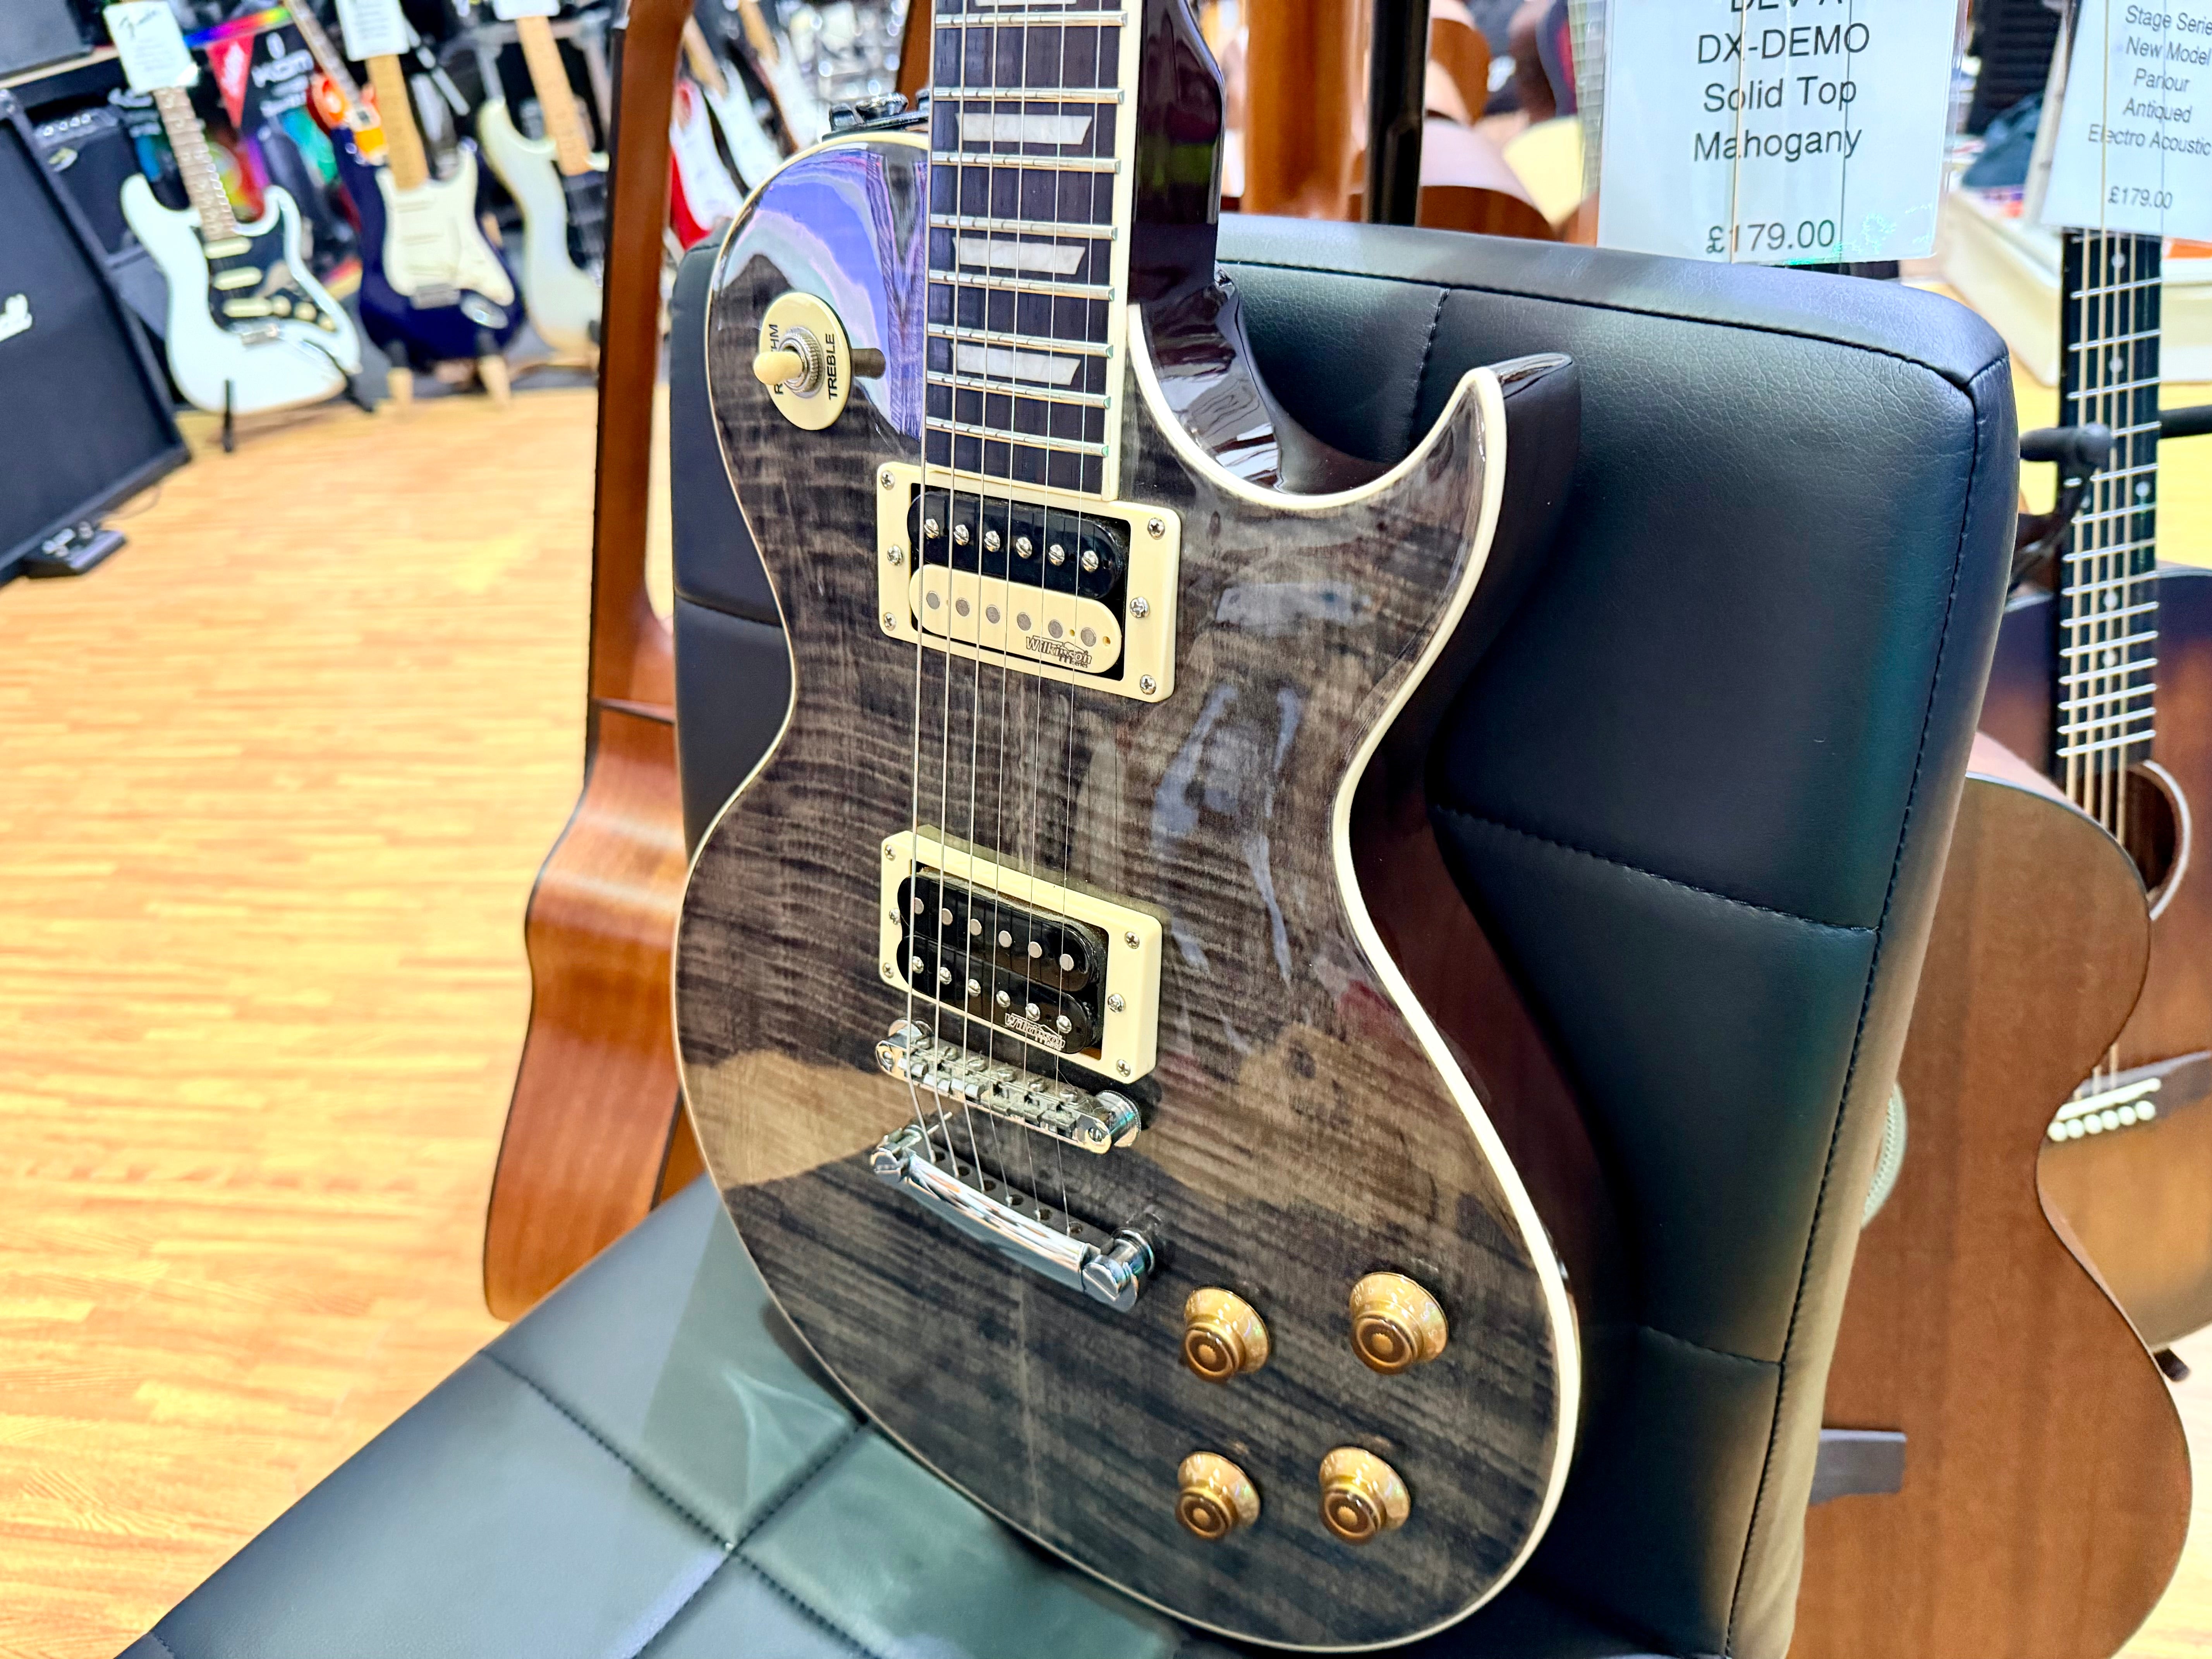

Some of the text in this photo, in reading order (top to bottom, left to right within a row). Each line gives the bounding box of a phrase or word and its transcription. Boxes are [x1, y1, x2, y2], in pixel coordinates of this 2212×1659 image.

[2125, 5, 2212, 36] Stage Serie
[1698, 23, 1870, 64] DX-DEMO
[2126, 36, 2212, 65] New Model
[1704, 76, 1856, 112] Solid Top
[2123, 97, 2193, 124] Antiqued
[1694, 129, 1862, 163] Mahogany
[2088, 124, 2212, 156] Electro Acoustic
[2107, 186, 2173, 210] £179.00
[1706, 219, 1835, 254] £179.00
[768, 324, 784, 395] RHM
[825, 333, 838, 401] TREBLE
[1026, 635, 1092, 665] Wilkinson
